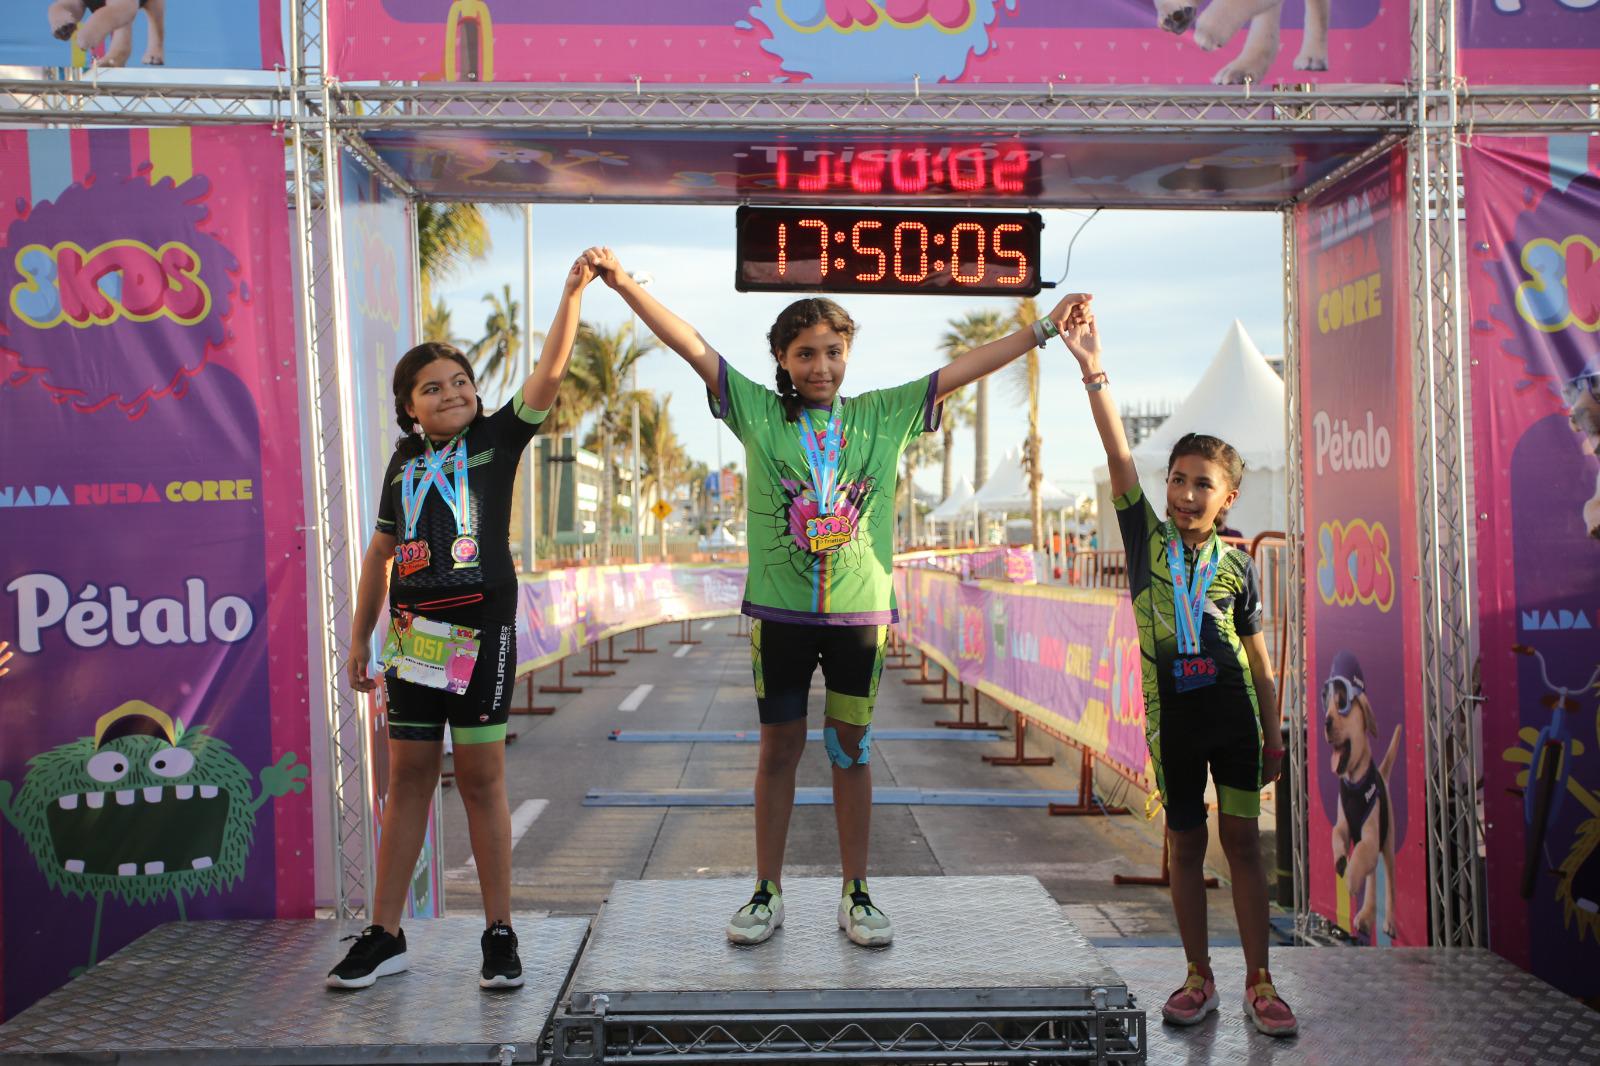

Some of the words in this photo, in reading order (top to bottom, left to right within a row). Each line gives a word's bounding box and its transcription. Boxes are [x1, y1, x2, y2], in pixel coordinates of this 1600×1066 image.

[1320, 188, 1375, 250] NADA
[777, 219, 1027, 285] 17:50:05
[1317, 273, 1383, 335] CORRE
[1313, 410, 1391, 476] Pétalo
[74, 482, 161, 505] RUEDA
[165, 479, 253, 503] CORRE
[6, 573, 254, 653] Pétalo
[1521, 609, 1593, 630] NADA
[413, 635, 444, 662] 051
[492, 625, 508, 710] TIBURONES
